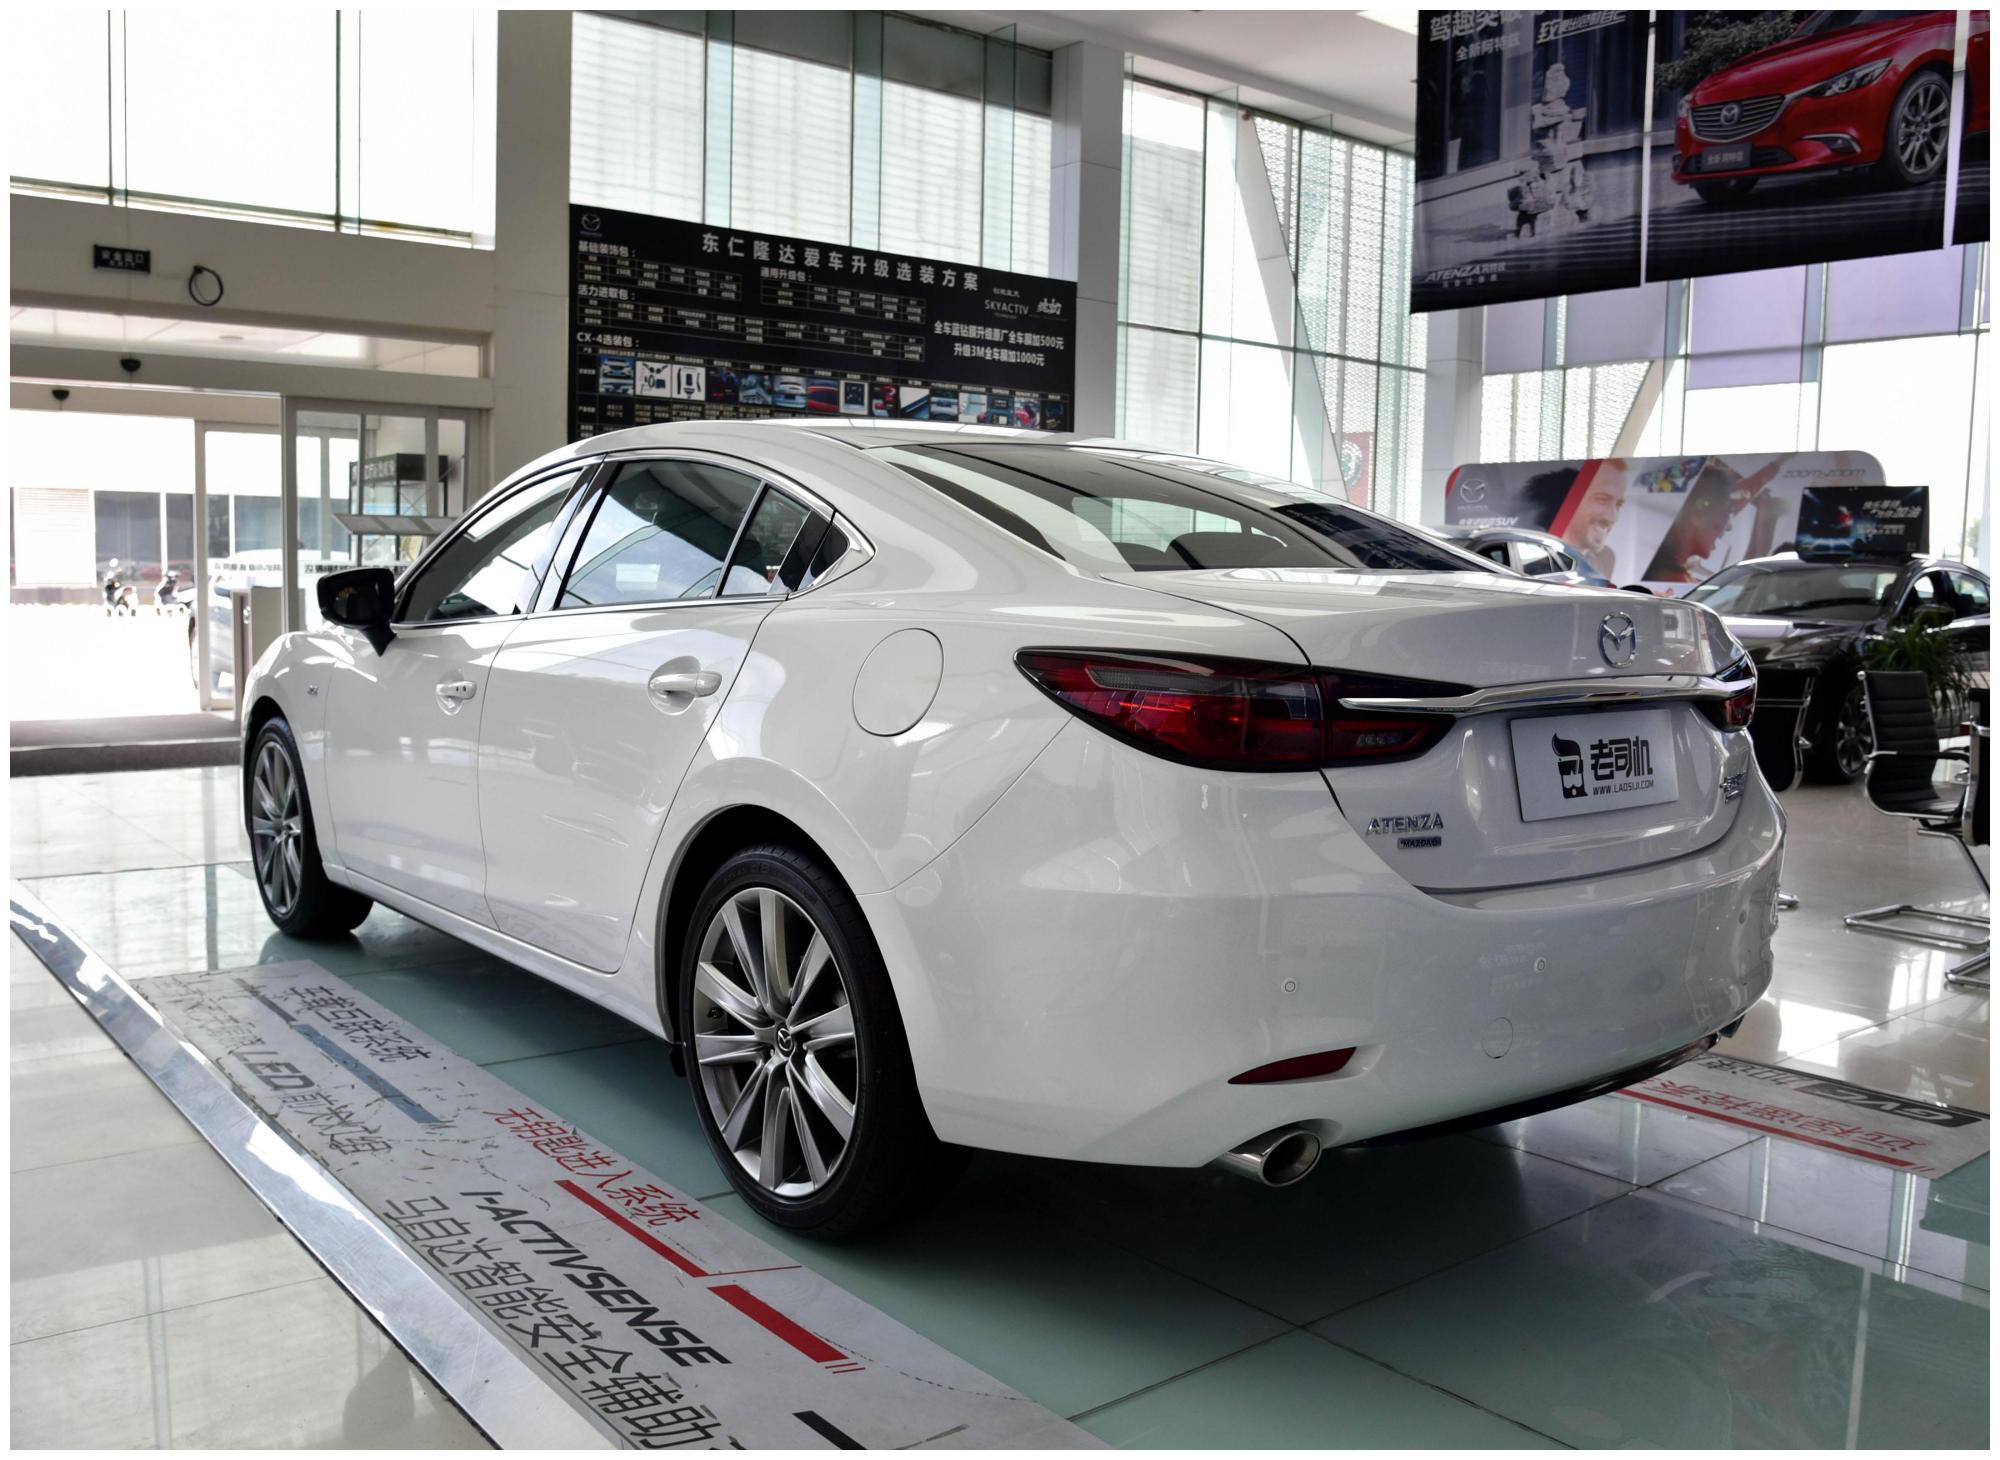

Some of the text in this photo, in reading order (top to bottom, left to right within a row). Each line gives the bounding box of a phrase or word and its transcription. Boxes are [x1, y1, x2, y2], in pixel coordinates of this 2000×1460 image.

[702, 232, 979, 291] 东仁隆达爱车升级选装方案
[1424, 263, 1481, 282] ATENZA
[984, 300, 1030, 316] SKYACTIV
[1590, 736, 1654, 781] 老司机
[1592, 780, 1655, 796] WWW.LAOSIJI.COM
[1365, 812, 1444, 836] ATENZA
[289, 985, 433, 1063] 车载互联系统
[482, 1107, 700, 1226] 无钥匙进入系统
[460, 1191, 733, 1368] I-ACTIVSENSE
[382, 1196, 747, 1450] 马自达智能安全辅助
